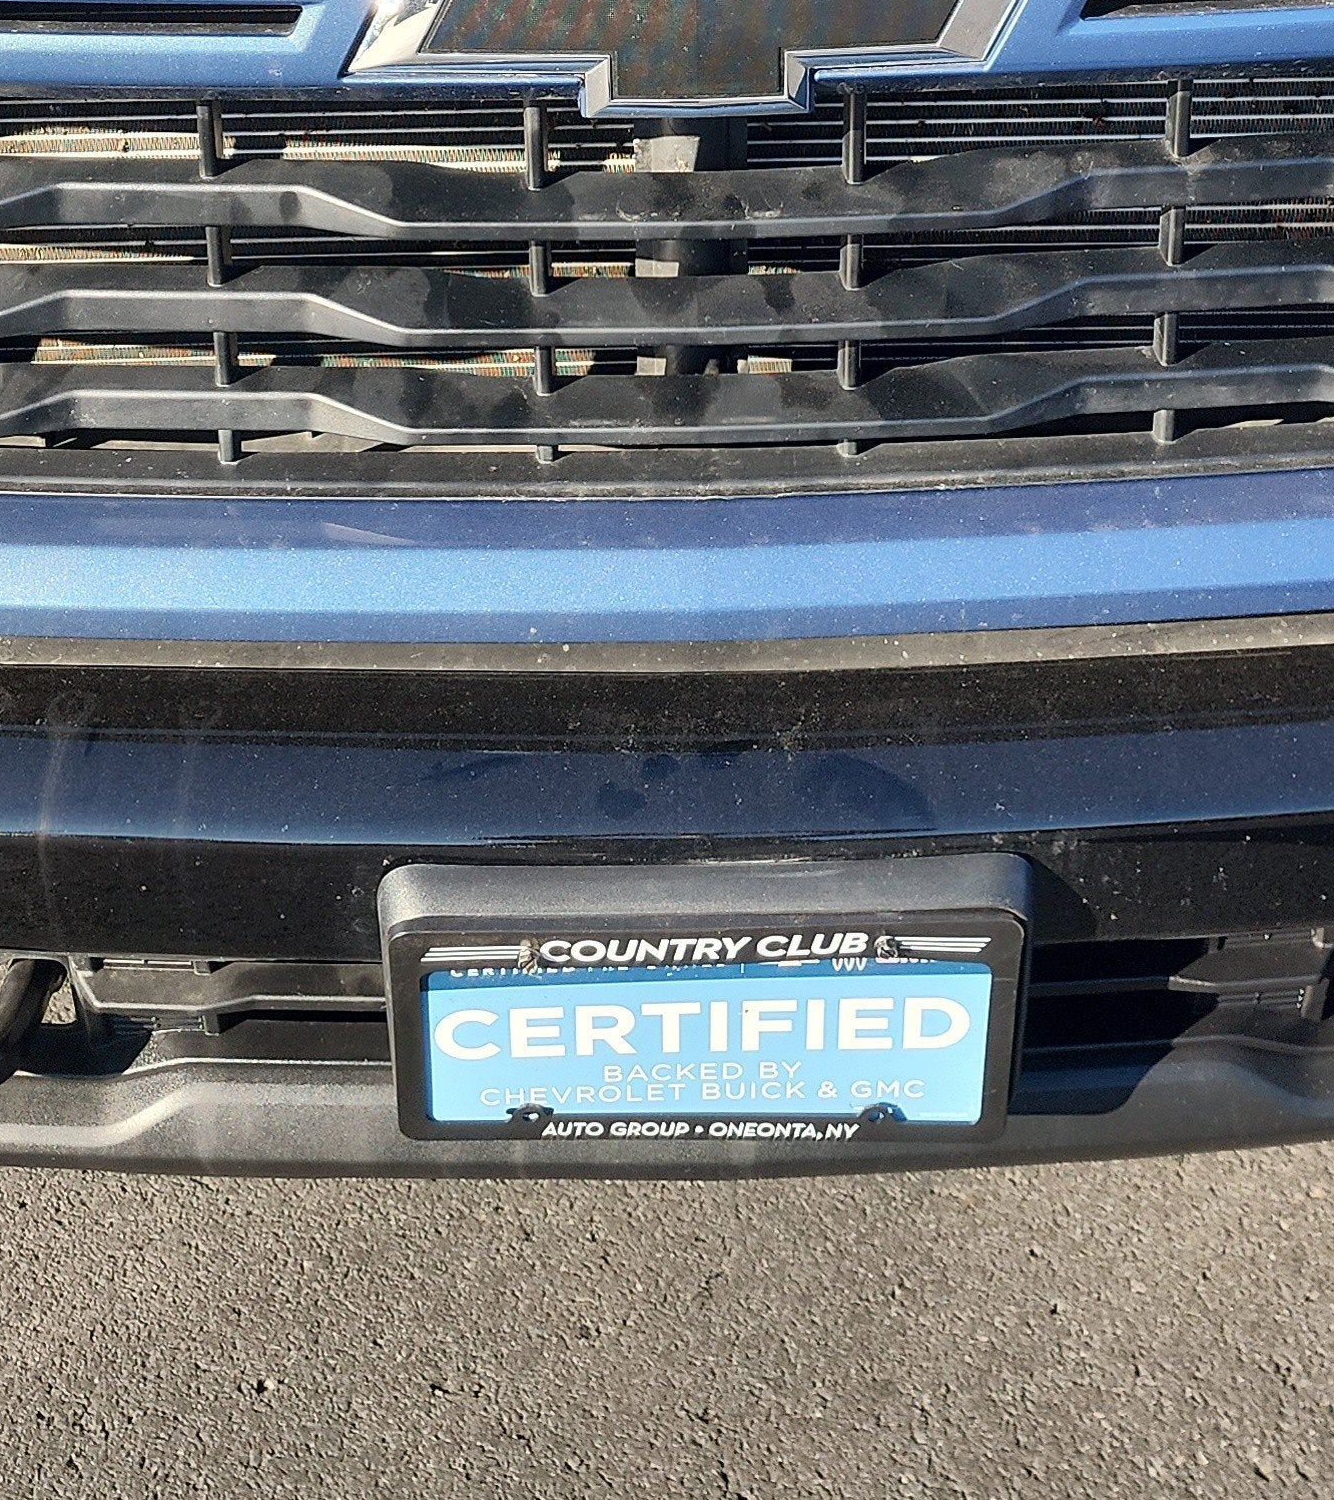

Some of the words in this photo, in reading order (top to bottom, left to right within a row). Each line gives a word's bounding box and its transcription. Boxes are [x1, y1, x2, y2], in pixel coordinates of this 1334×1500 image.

[540, 936, 752, 963] COUNTRY
[756, 932, 870, 958] CLUB
[434, 996, 971, 1061] CERTIFIED
[603, 1063, 744, 1083] BACKED
[758, 1061, 802, 1080] BY
[479, 1083, 686, 1106] CHEVROLET
[701, 1081, 806, 1100] BUICK
[816, 1080, 838, 1099] &
[850, 1079, 926, 1099] GMC
[541, 1121, 605, 1138] AUTO
[610, 1121, 691, 1138] GROUP
